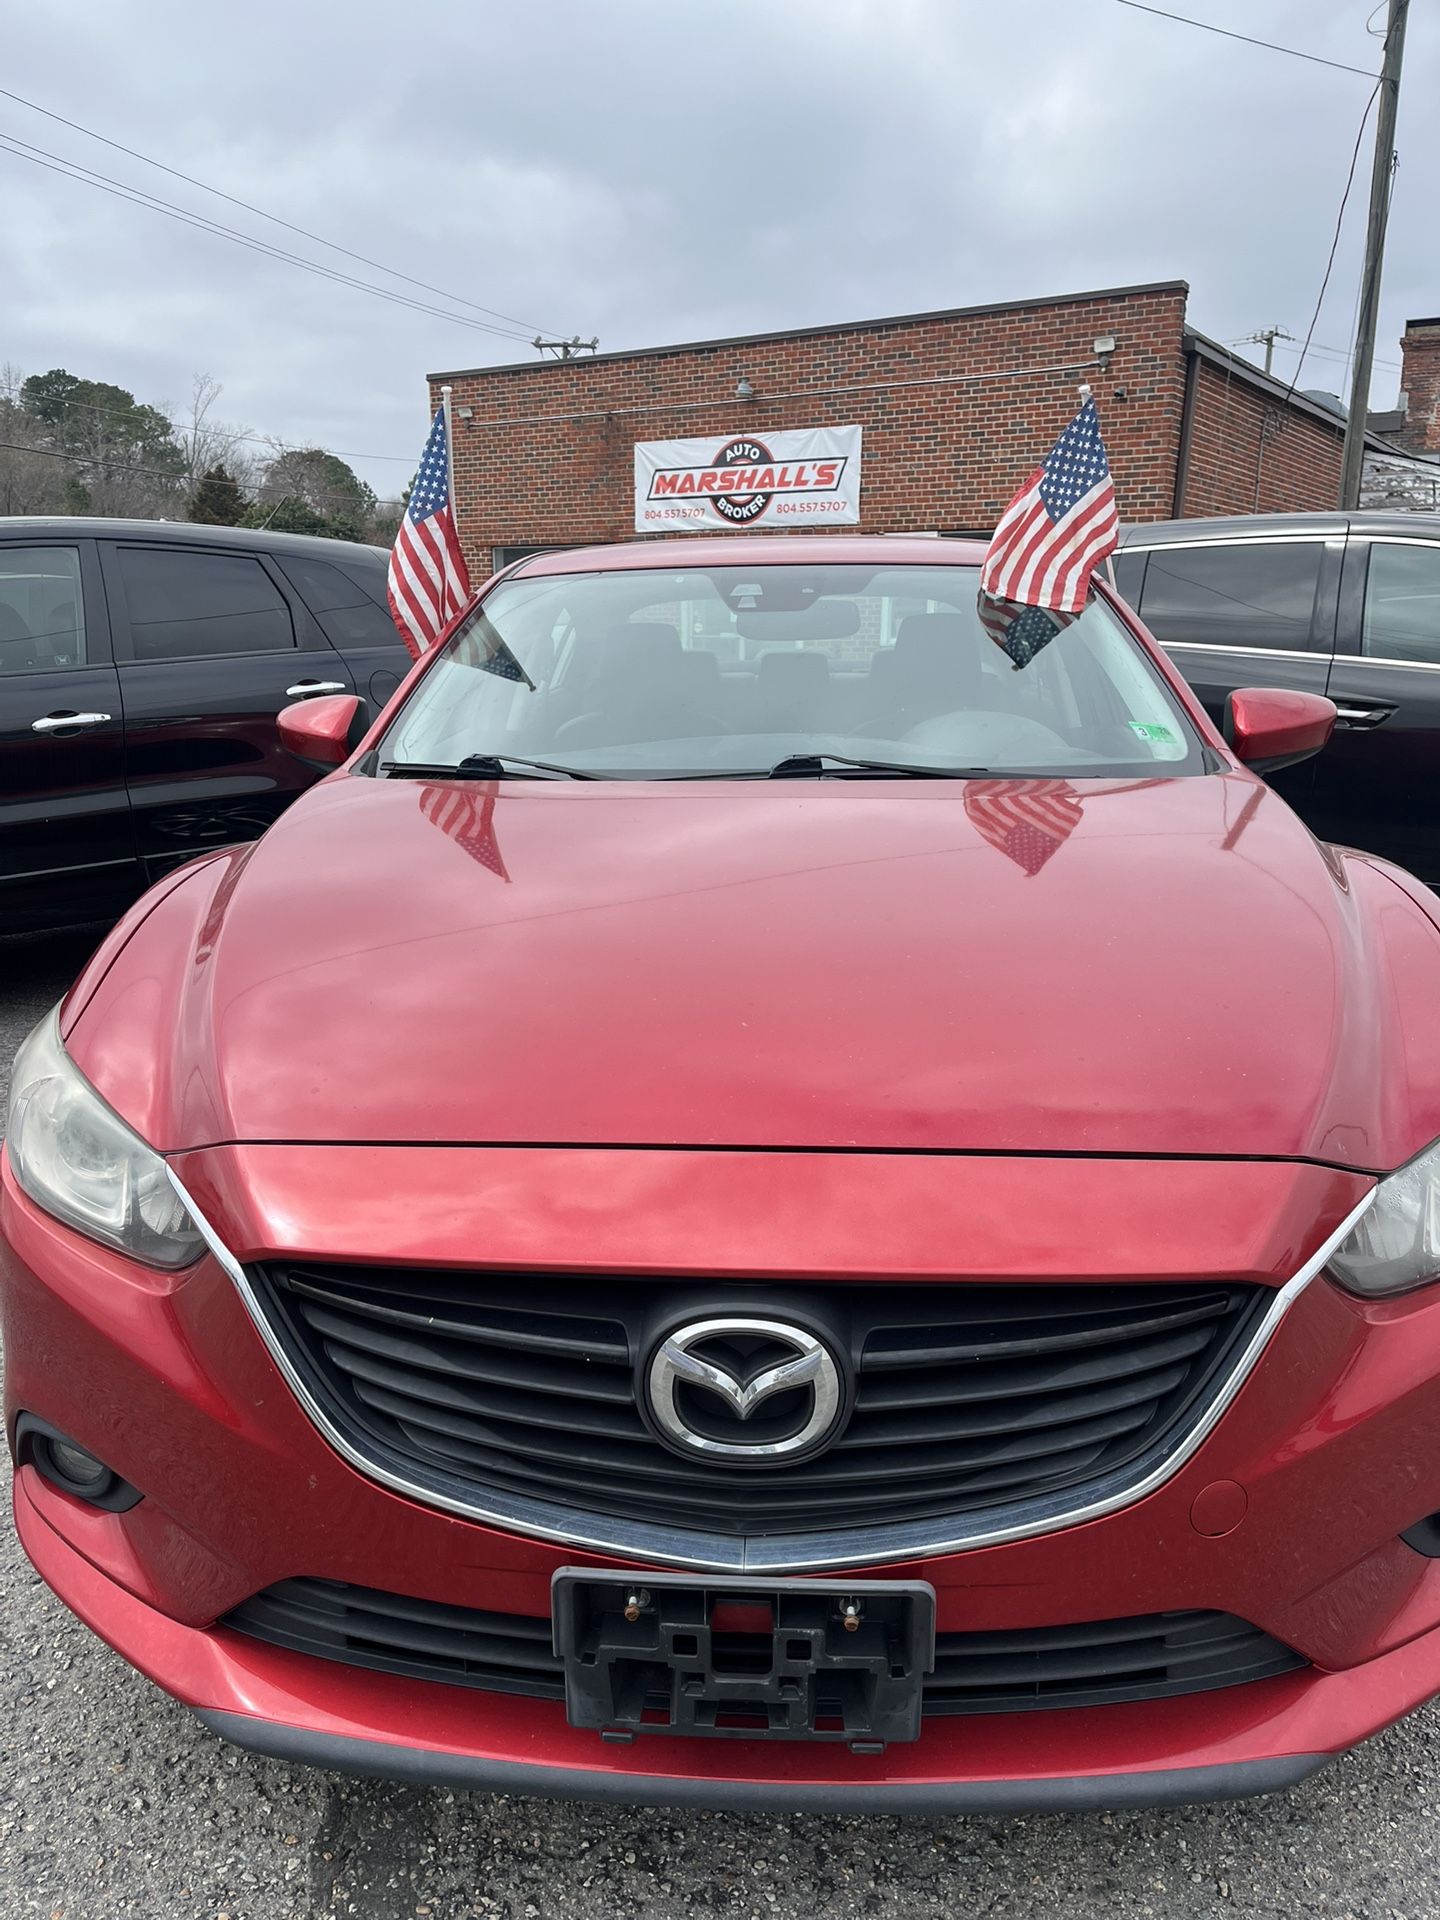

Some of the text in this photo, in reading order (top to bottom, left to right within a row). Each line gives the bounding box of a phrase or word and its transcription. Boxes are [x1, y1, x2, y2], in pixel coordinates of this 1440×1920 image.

[726, 443, 760, 462] AUTO
[654, 463, 839, 494] MARSHALL'S
[717, 494, 767, 519] BROKER
[776, 501, 847, 514] 804.557.5707
